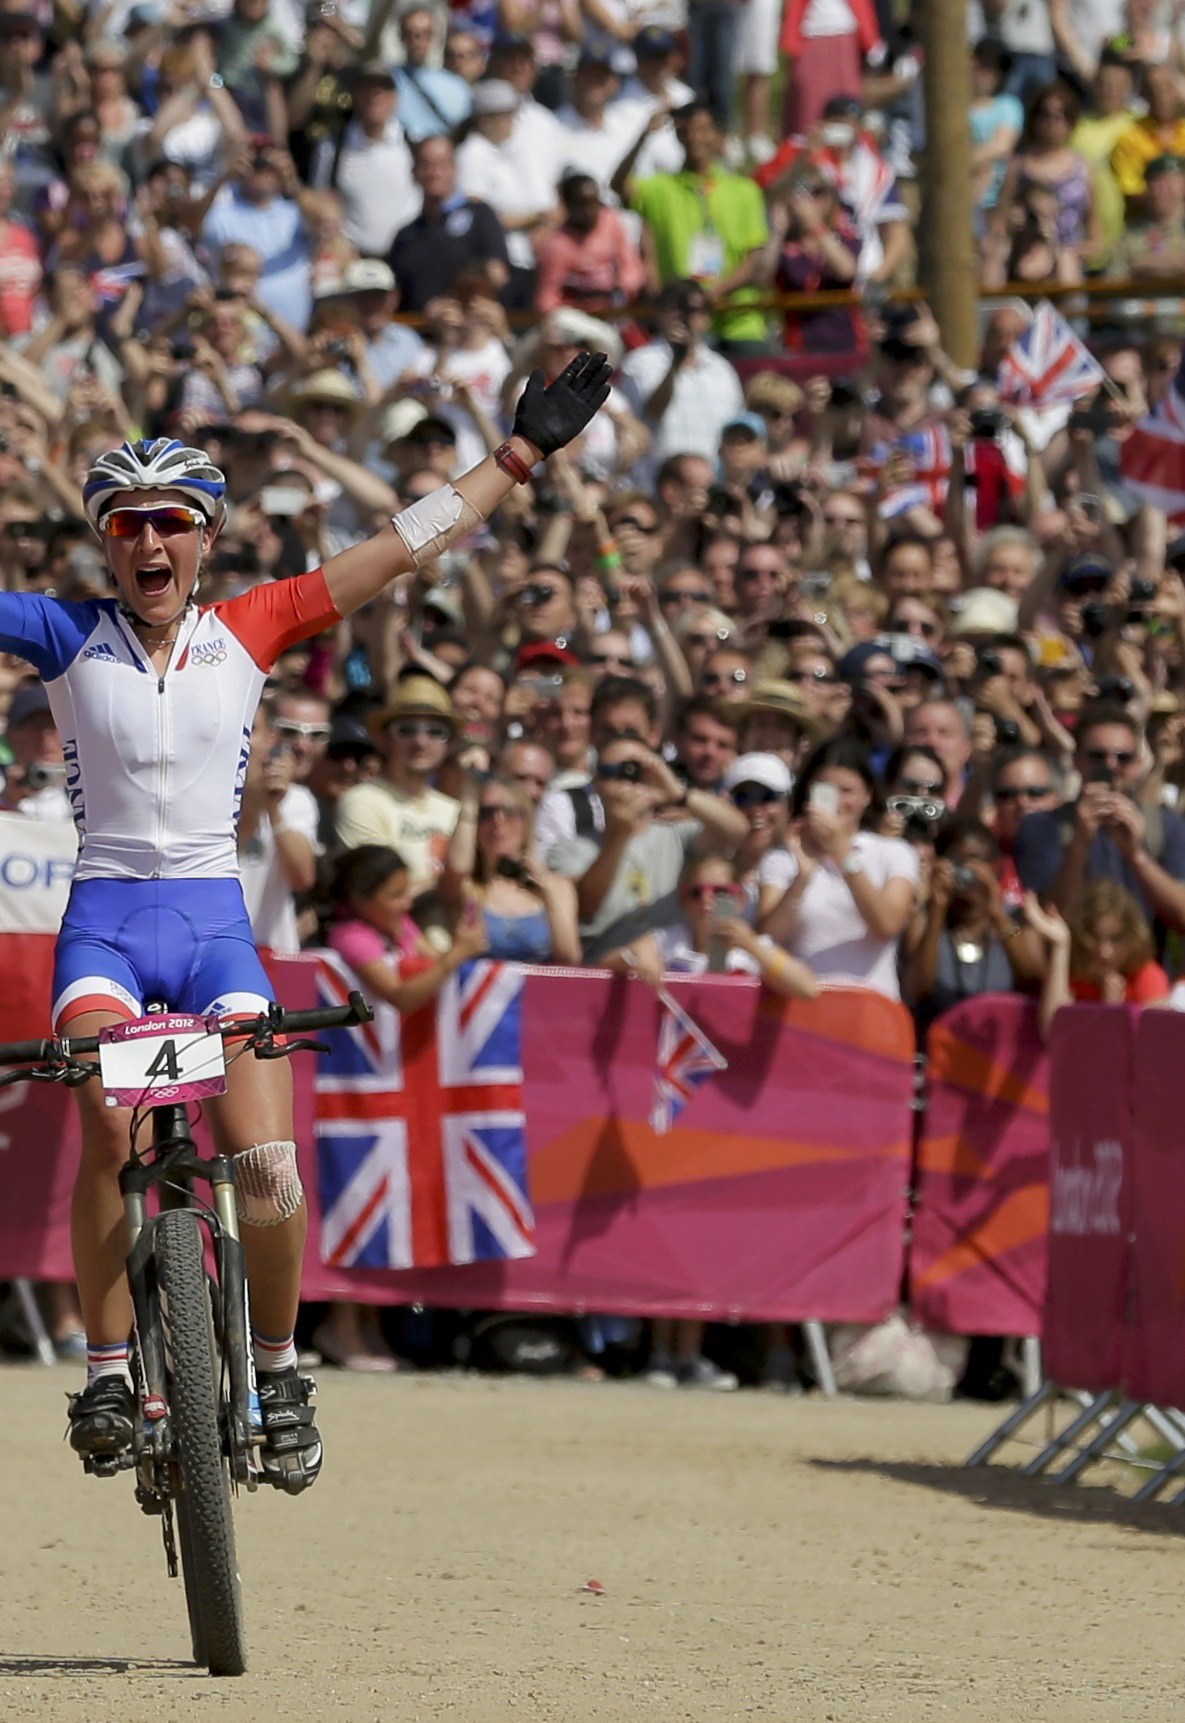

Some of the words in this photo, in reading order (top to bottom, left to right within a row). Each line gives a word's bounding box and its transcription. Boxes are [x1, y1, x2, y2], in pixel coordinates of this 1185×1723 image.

[191, 637, 225, 656] FRANCE
[84, 649, 121, 663] adidas
[125, 1021, 166, 1035] London
[169, 1018, 195, 1029] 2012
[145, 1039, 183, 1080] 4
